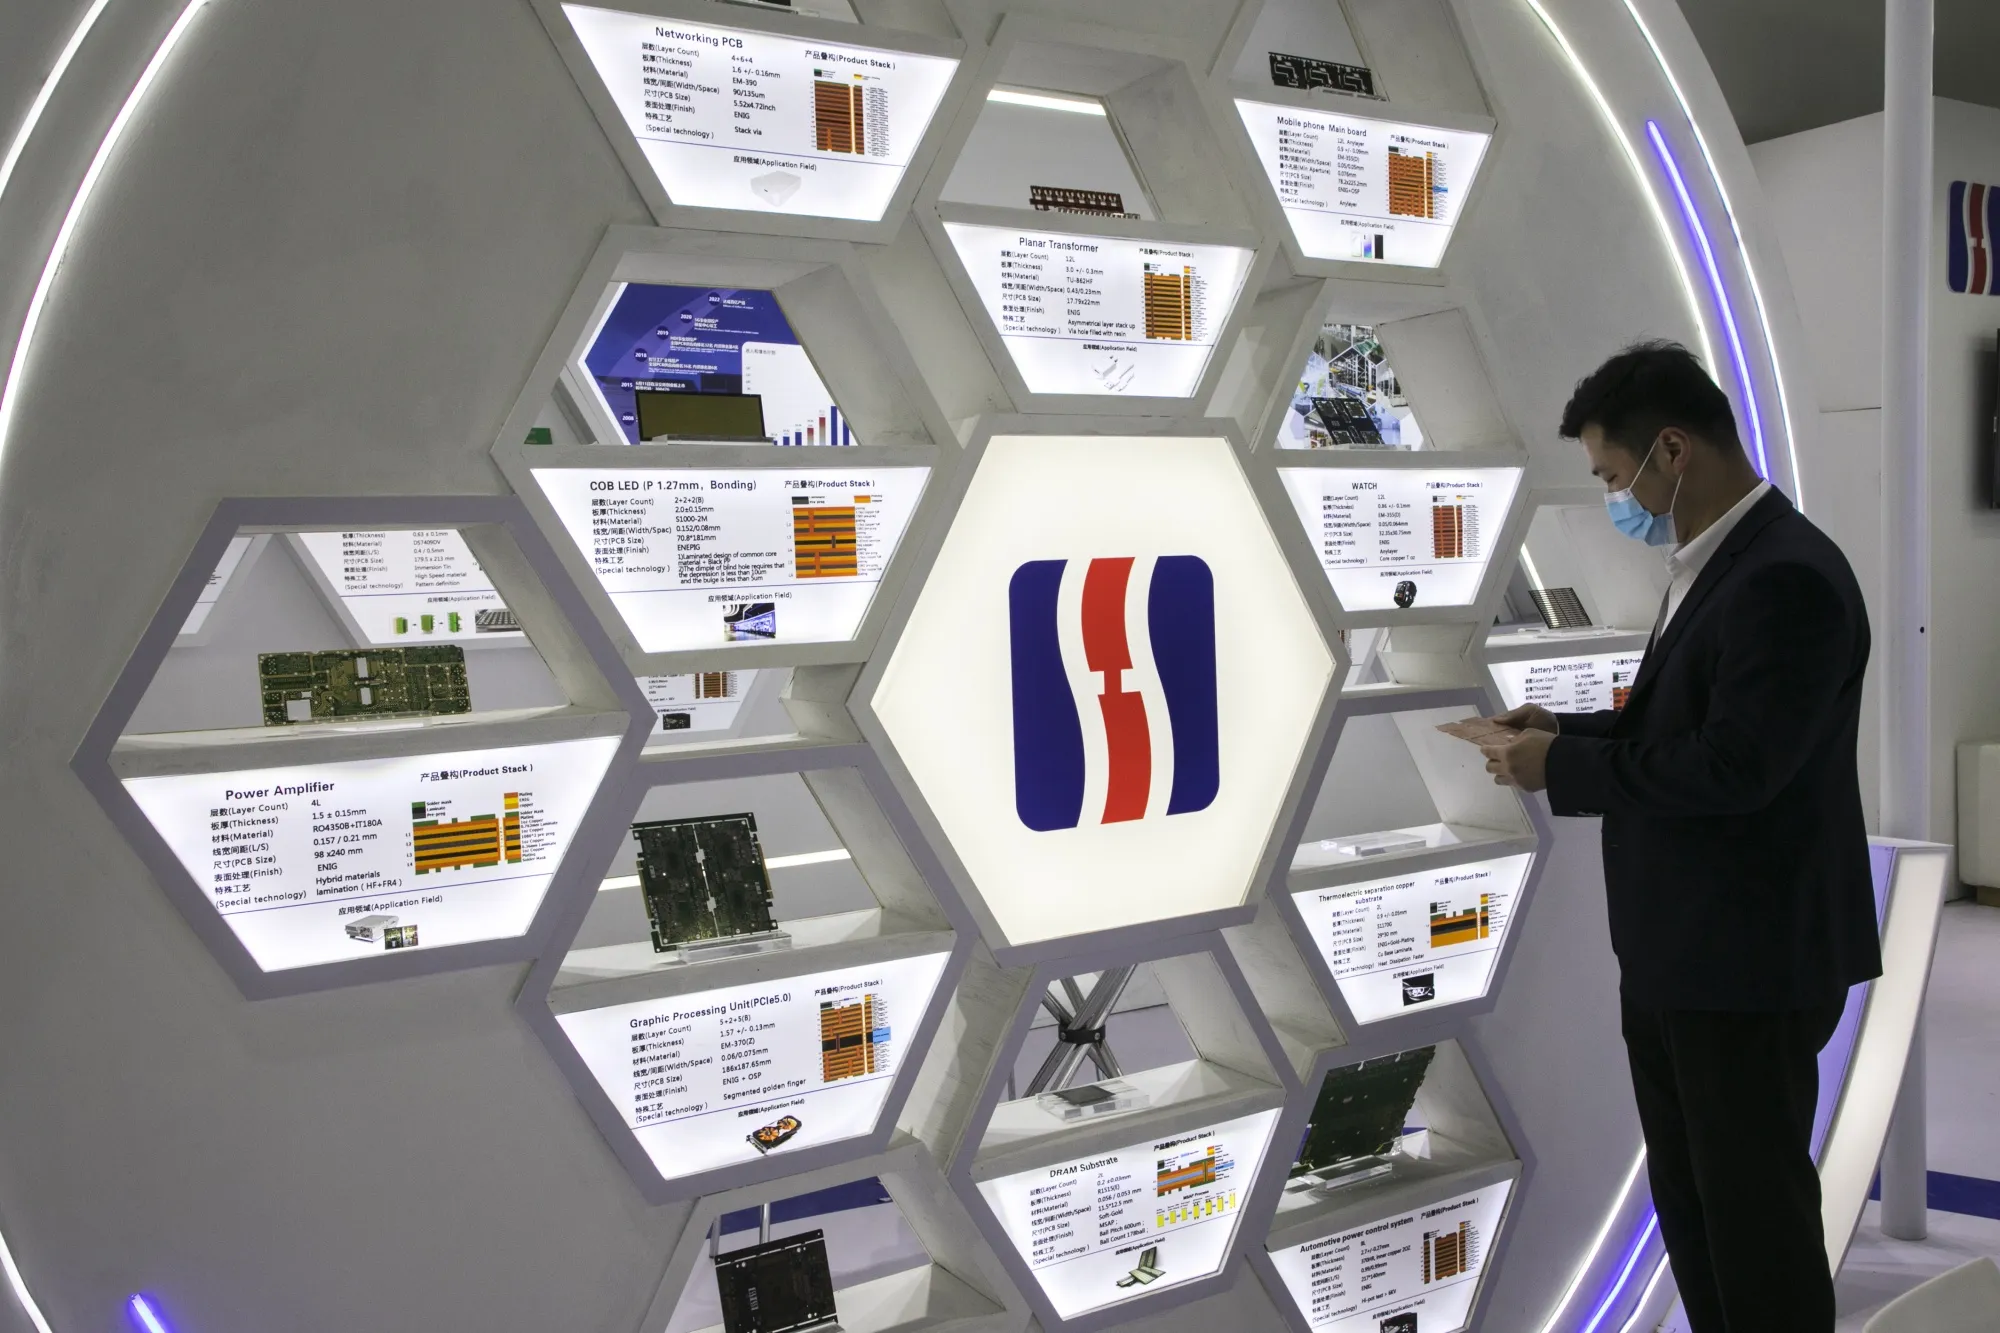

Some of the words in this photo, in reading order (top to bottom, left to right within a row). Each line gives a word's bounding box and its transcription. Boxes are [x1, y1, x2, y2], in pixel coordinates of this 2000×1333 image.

[655, 26, 719, 47] Networking
[722, 37, 743, 48] PCB
[731, 55, 753, 64] 4+6+4
[755, 69, 781, 78] 0.16mm
[732, 77, 757, 87] EM-390
[733, 88, 765, 99] 90/135um
[734, 111, 750, 119] ENIG
[734, 126, 751, 134] Stack
[1277, 116, 1301, 127] Mobile
[1303, 121, 1325, 131] phone
[1329, 124, 1345, 134] Main
[1347, 127, 1367, 137] board
[1019, 237, 1046, 248] Planar
[1049, 240, 1099, 252] Transformer
[1068, 319, 1101, 327] Asymmetrical
[590, 481, 614, 491] COB
[618, 481, 639, 491] LED
[710, 480, 756, 491] Bonding)
[1352, 482, 1377, 490] WATCH
[592, 499, 628, 507] 层数(Layer
[630, 498, 654, 506] Count)
[674, 496, 704, 504] 2+2+2(B)
[592, 508, 646, 516] 板厚(Thickness)
[675, 515, 708, 523] S1000-2M
[676, 524, 721, 532] 0.152/0.08mm
[594, 537, 626, 545] 尺寸(PCB
[627, 537, 644, 545] Size)
[677, 543, 701, 551] ENEPIG
[595, 556, 624, 564] 特殊工艺
[421, 768, 499, 782] 产品叠构(Product
[502, 764, 527, 774] Stack
[226, 789, 269, 801] Power
[274, 782, 335, 796] Amplifier
[210, 807, 255, 817] 层数(Layer
[258, 802, 288, 812] Count)
[312, 812, 324, 820] 1.5
[334, 809, 367, 818] 0.15mm
[211, 816, 278, 831] 板厚(Thickness)
[313, 819, 383, 833] RO4350B+IT180A
[212, 829, 273, 843] 材料(Material)
[313, 836, 335, 846] 0.157
[343, 834, 360, 843] 0.21
[212, 843, 269, 856] 线宽间距(L/S)
[314, 851, 325, 859] 98
[326, 848, 346, 857] x240
[213, 857, 253, 869] 尺寸(PCB
[255, 855, 276, 864] Size)
[317, 862, 338, 872] ENIG
[214, 867, 283, 882] 表面处理(Finish)
[316, 874, 343, 885] Hybrid
[345, 871, 380, 881] materials
[215, 883, 251, 895] 特殊工艺
[316, 885, 359, 896] lamination
[366, 879, 397, 889] HF+FR4
[1318, 890, 1362, 902] Thermoelectric
[1364, 885, 1394, 895] separation
[1395, 882, 1415, 890] copper
[214, 896, 251, 910] (Special
[254, 890, 307, 903] technology)
[338, 899, 419, 915] 应用领域(Application
[421, 895, 443, 904] Field)
[1355, 896, 1383, 904] substrate
[630, 1014, 670, 1028] Graphic
[673, 1006, 726, 1021] Processing
[729, 993, 791, 1011] Unit(PCIe5.0)
[720, 1014, 751, 1025] 5+2+5(B)
[720, 1028, 734, 1038] 1.57
[736, 1027, 747, 1035] +/-
[749, 1023, 775, 1032] 0.13mm
[721, 1037, 755, 1050] EM-370(Z)
[633, 1051, 680, 1066] 材料(Material)
[721, 1048, 768, 1062] 0.06/0.075mm
[722, 1059, 772, 1074] 186x187.65mm
[634, 1077, 664, 1090] 尺寸(PCB
[666, 1074, 682, 1083] Size)
[722, 1076, 739, 1085] ENIG
[748, 1072, 762, 1080] OSP
[723, 1087, 761, 1100] Segmented
[762, 1083, 785, 1094] golden
[787, 1079, 806, 1087] finger
[635, 1102, 663, 1113] 特殊工艺
[1050, 1165, 1077, 1178] DRAM
[1080, 1157, 1118, 1172] Substrate
[1299, 1237, 1341, 1253] Automotive
[1342, 1231, 1364, 1243] power
[1365, 1222, 1389, 1235] control
[1390, 1217, 1414, 1229] system
